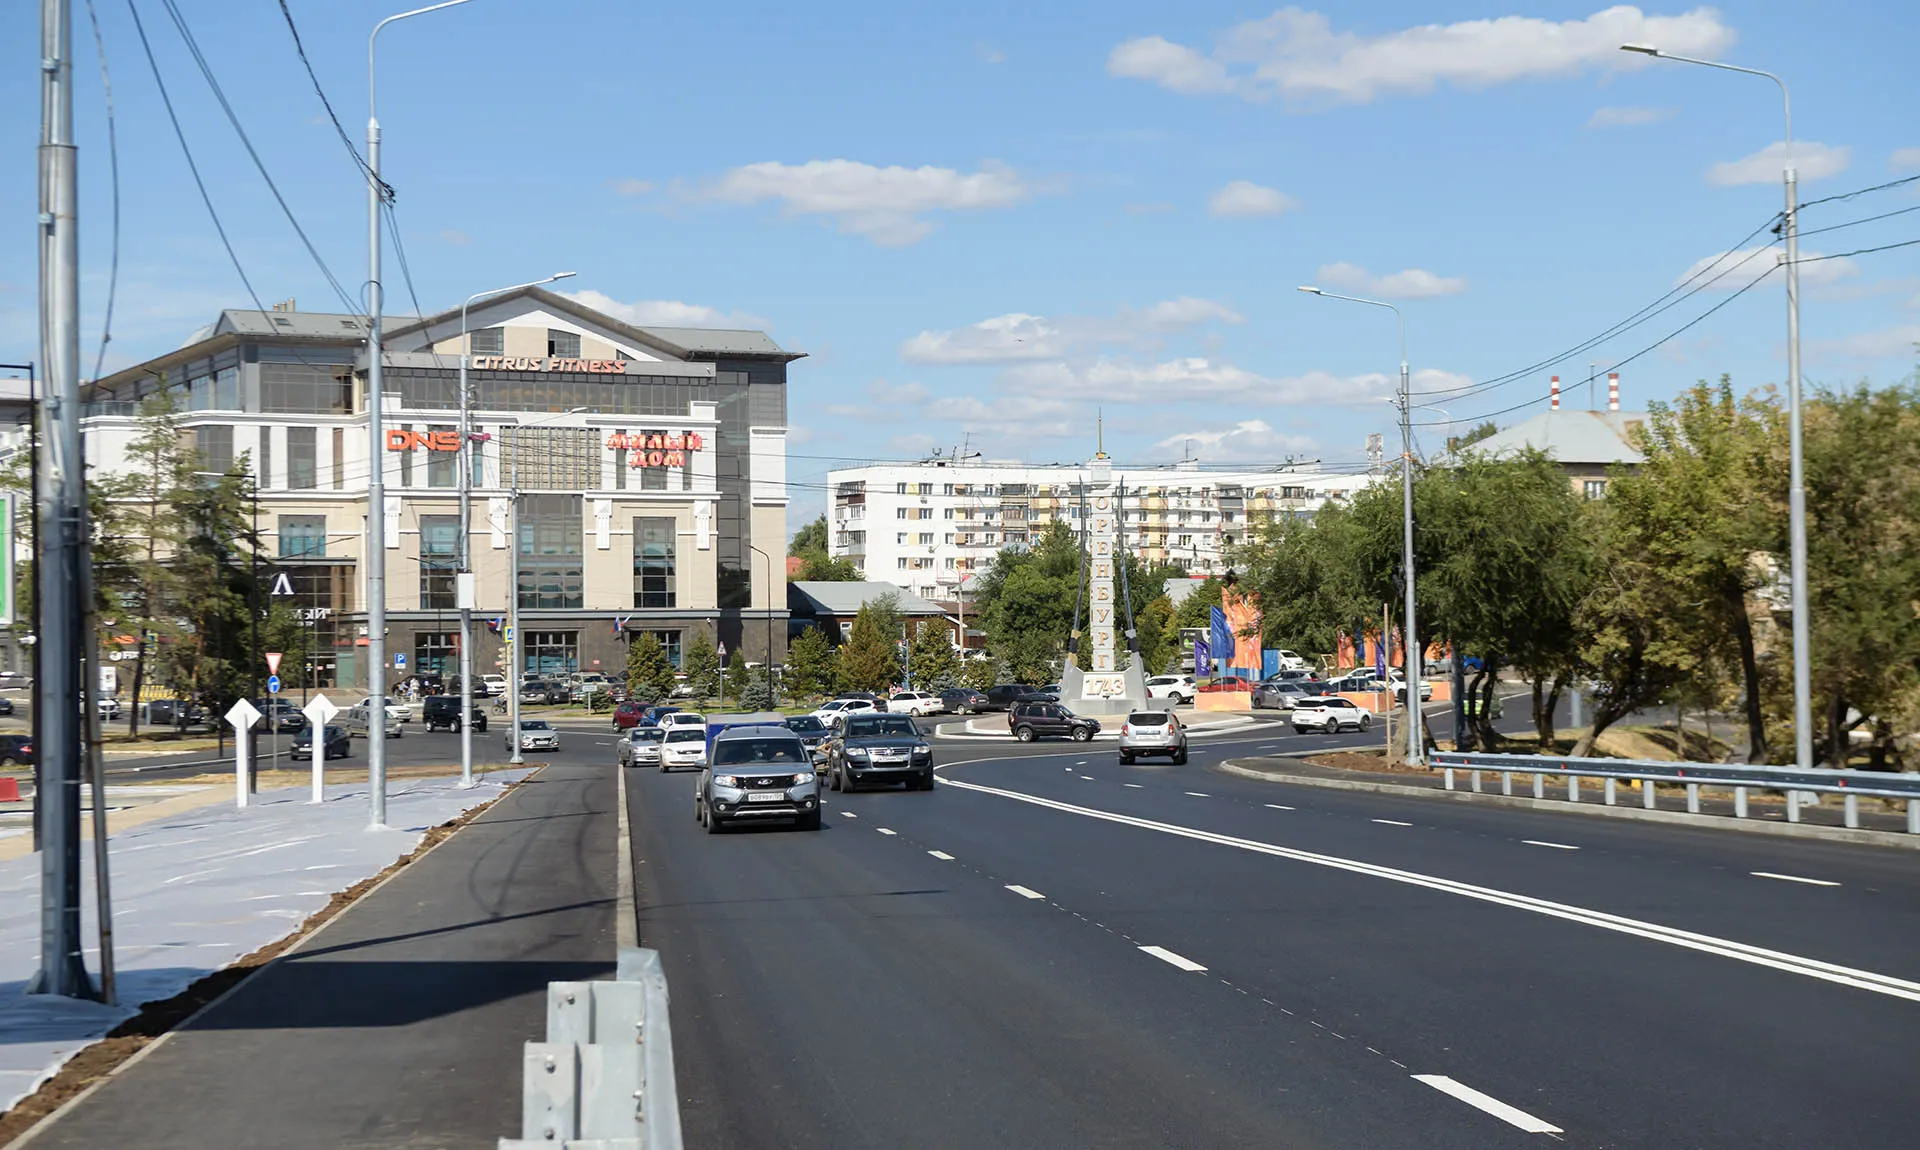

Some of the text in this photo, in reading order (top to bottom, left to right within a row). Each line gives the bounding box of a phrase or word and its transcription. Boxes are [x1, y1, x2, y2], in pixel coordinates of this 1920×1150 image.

[472, 355, 542, 372] CITRUS
[387, 429, 461, 451] DNS
[630, 450, 685, 468] ДОМ
[1095, 496, 1110, 669] ОРЕНБУРГ
[1085, 677, 1125, 696] 1743
